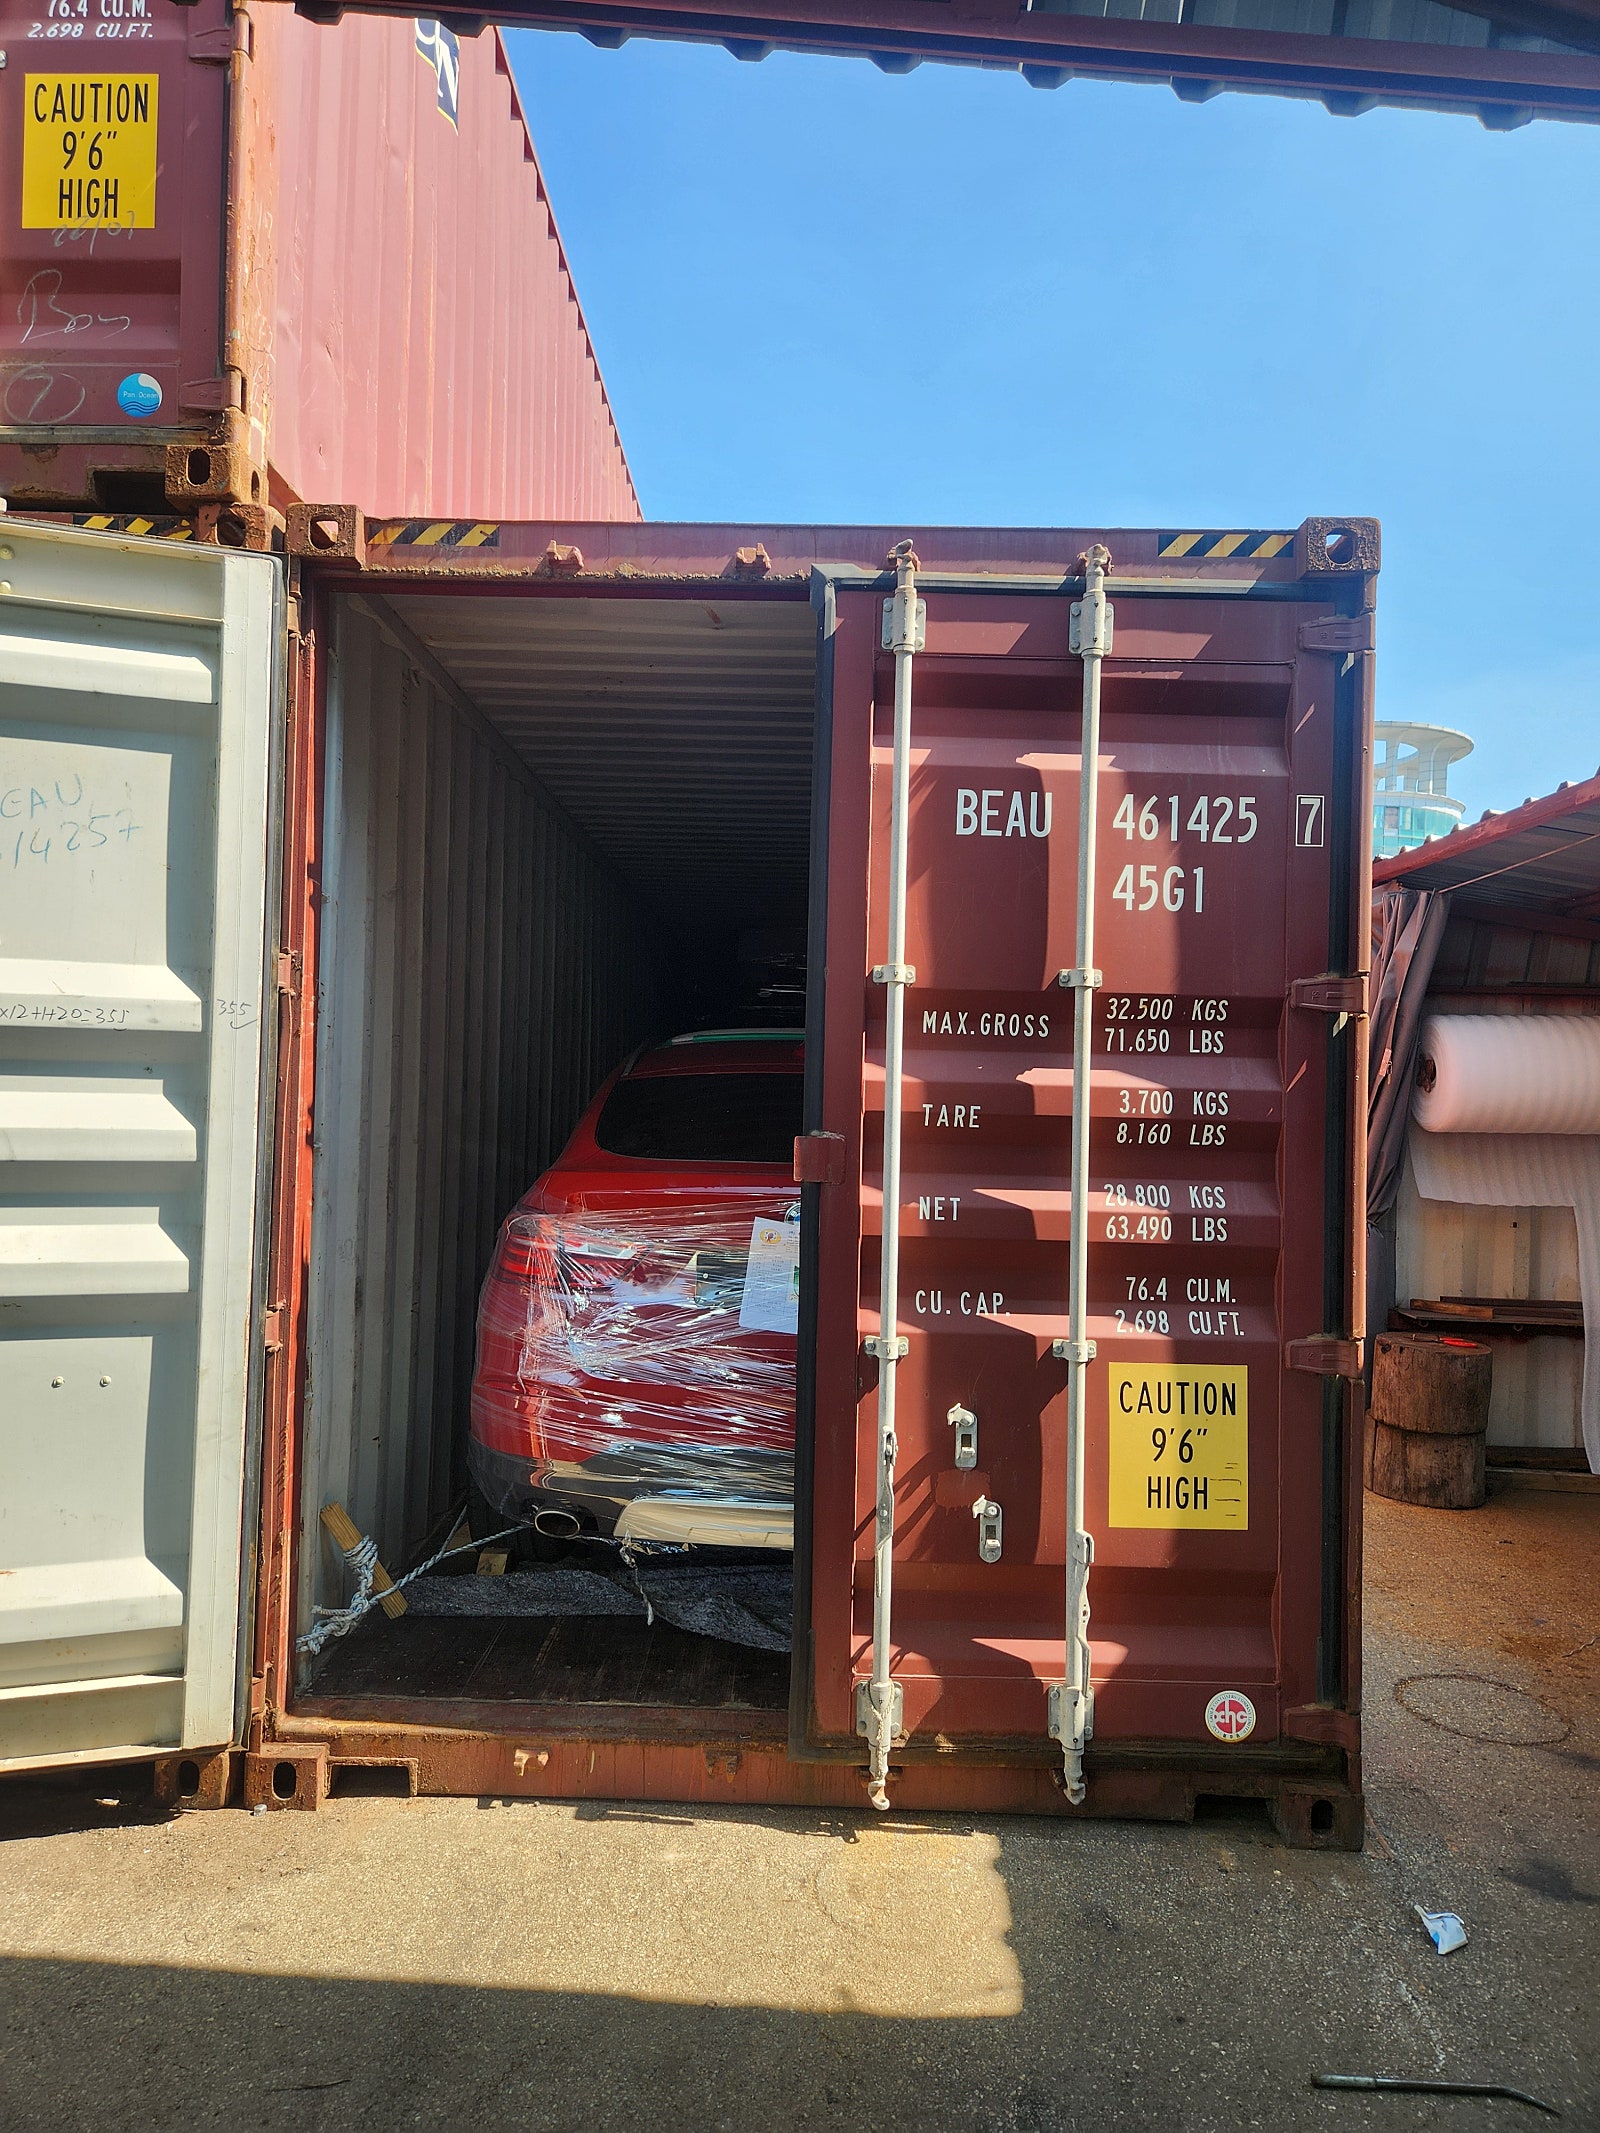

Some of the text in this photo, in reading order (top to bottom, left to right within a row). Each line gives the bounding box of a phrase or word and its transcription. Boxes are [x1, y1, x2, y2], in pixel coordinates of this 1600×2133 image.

[95, 23, 155, 39] CU.FT.
[33, 82, 150, 124] CAUTION
[58, 178, 119, 220] HIGH
[123, 390, 136, 399] Pan
[955, 788, 1321, 845] BEAU 461425 7
[0, 808, 145, 870] 14257
[1112, 864, 1205, 913] 45G1
[1191, 998, 1230, 1022] KGS
[1189, 1029, 1226, 1054] LBS
[922, 1103, 982, 1129] TARE
[1193, 1091, 1230, 1117] KGS
[1189, 1124, 1227, 1147] LBS
[919, 1197, 961, 1222] NET
[1188, 1185, 1227, 1210] KGS
[1191, 1217, 1229, 1243] LBS
[1125, 1276, 1169, 1302] 76.4
[1186, 1278, 1238, 1304] CU.M.
[1188, 1311, 1246, 1337] CU.FT.
[1119, 1380, 1237, 1416] CAUTION
[1147, 1475, 1209, 1511] HIGH
